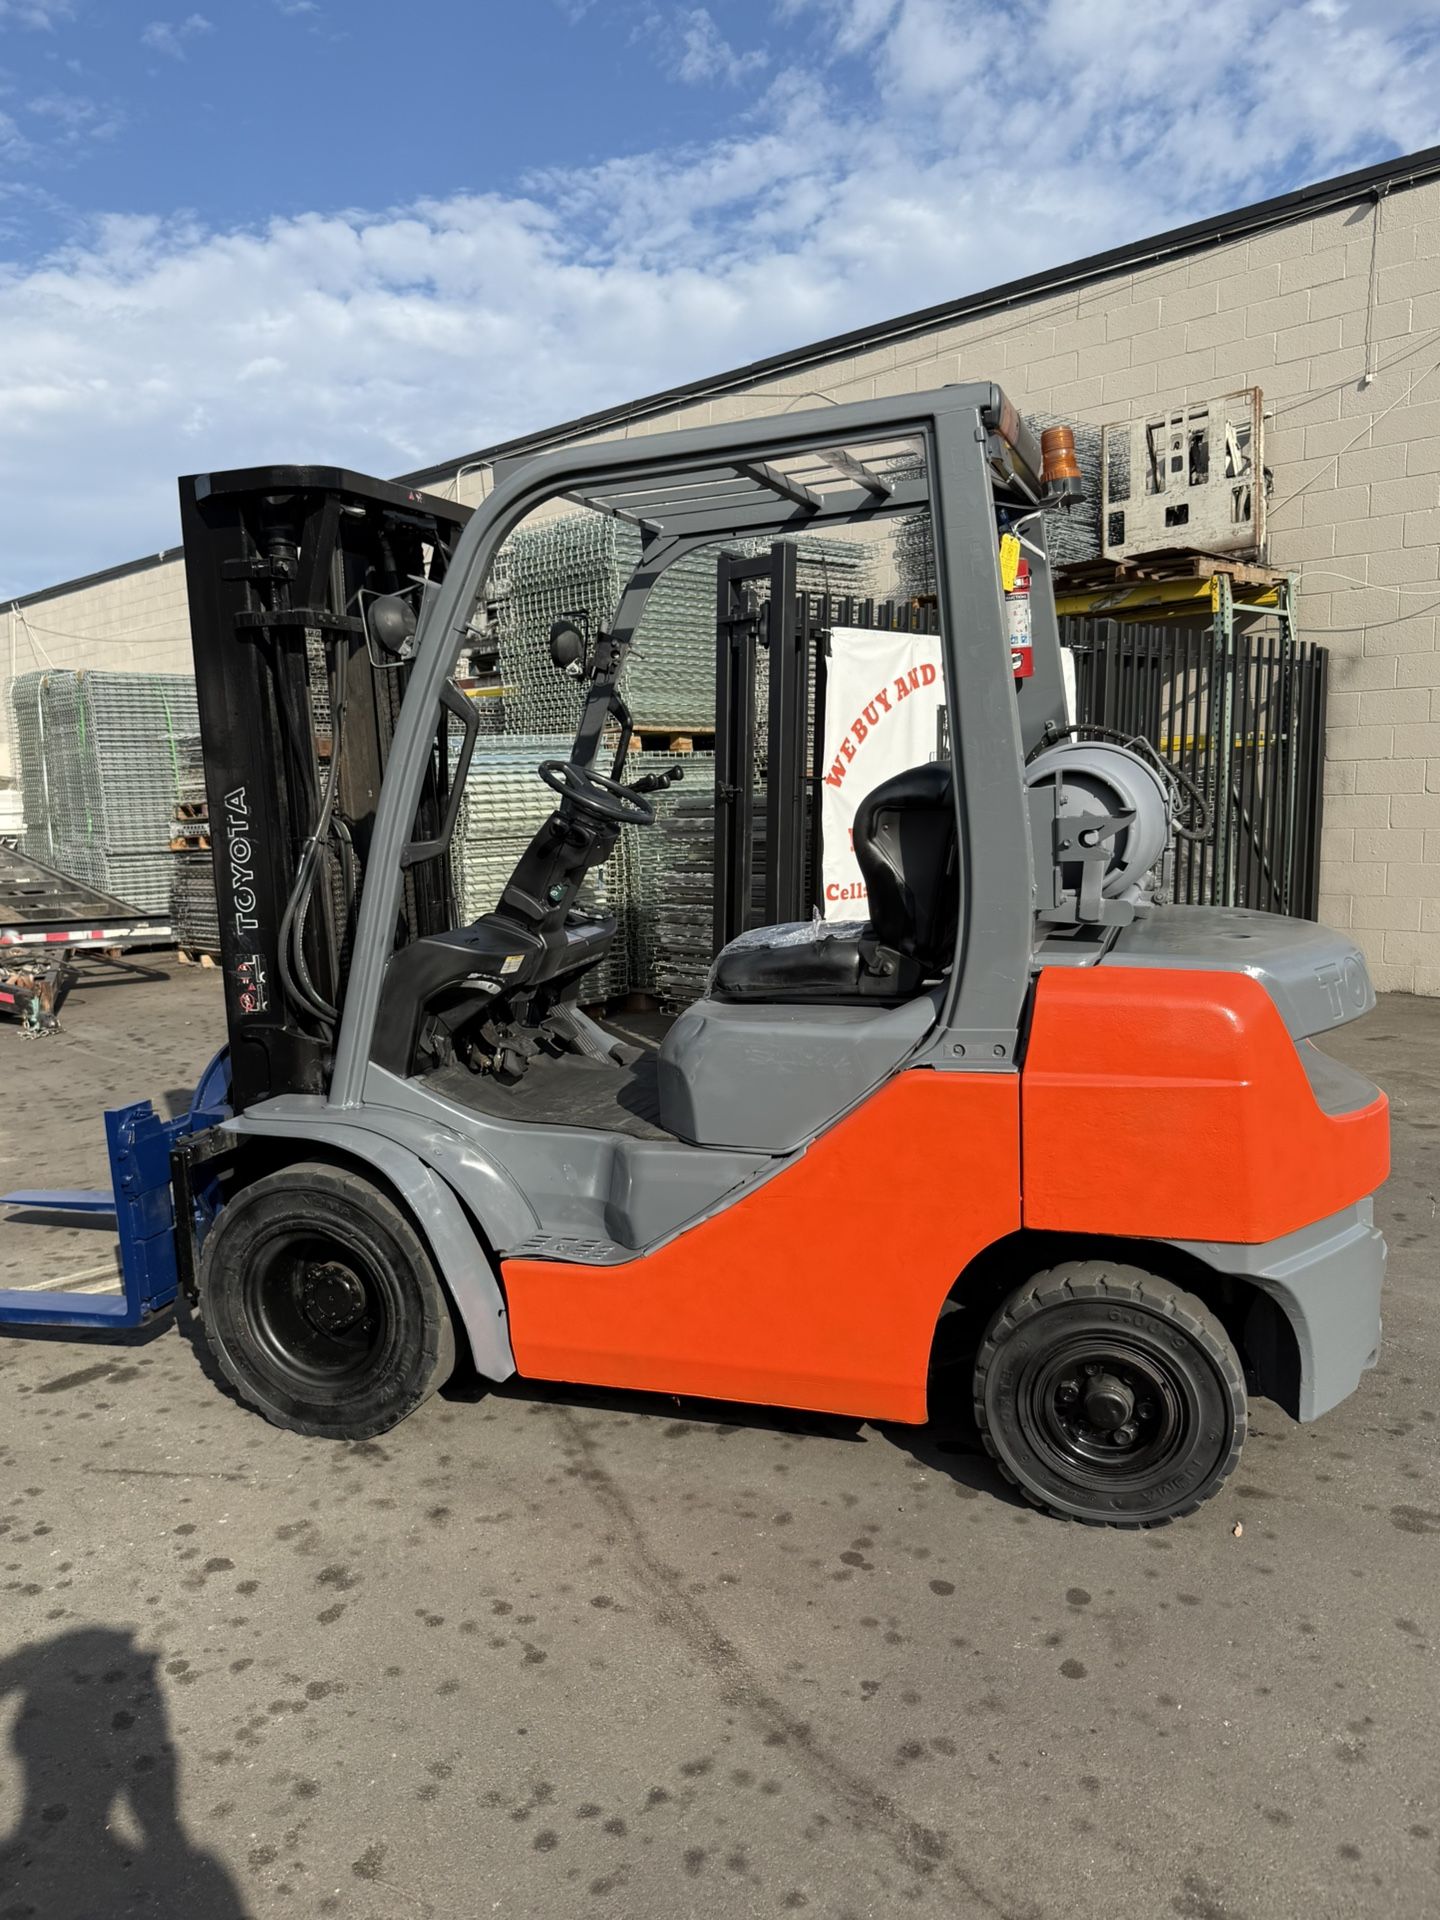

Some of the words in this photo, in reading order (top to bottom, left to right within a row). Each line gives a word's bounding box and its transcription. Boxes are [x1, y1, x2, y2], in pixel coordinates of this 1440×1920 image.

[825, 740, 857, 790] WE
[850, 688, 893, 745] BUY
[894, 662, 936, 703] AND
[224, 786, 259, 936] TOYOTA
[1313, 950, 1367, 1020] TO
